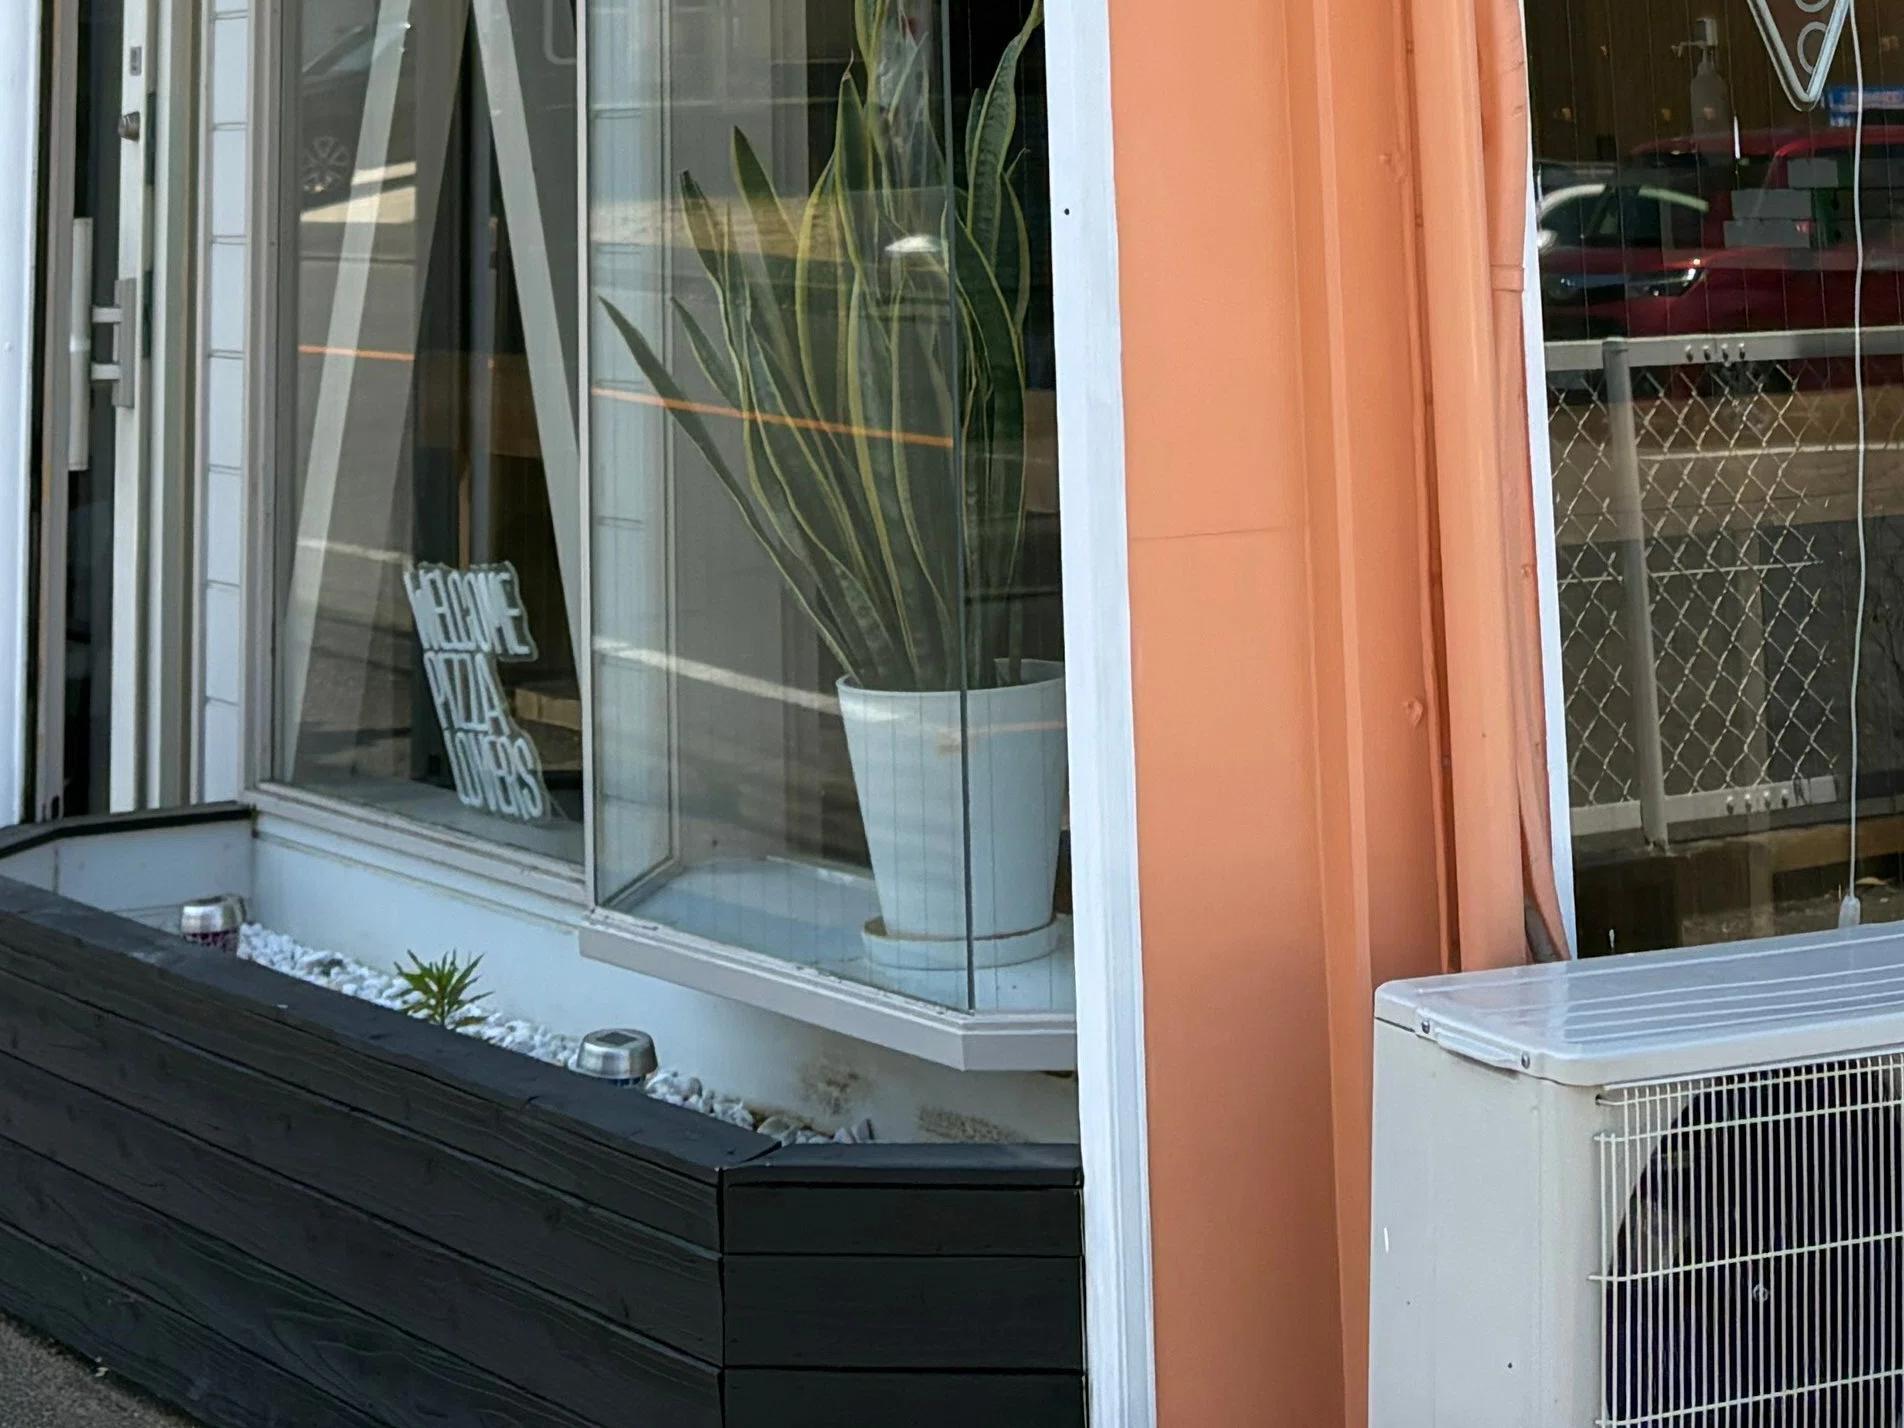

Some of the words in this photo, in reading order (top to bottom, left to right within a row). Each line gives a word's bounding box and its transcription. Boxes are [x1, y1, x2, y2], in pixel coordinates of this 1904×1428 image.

[403, 570, 530, 655] WELCOME
[424, 650, 509, 735] PIZZA
[444, 730, 543, 821] LOVERS
